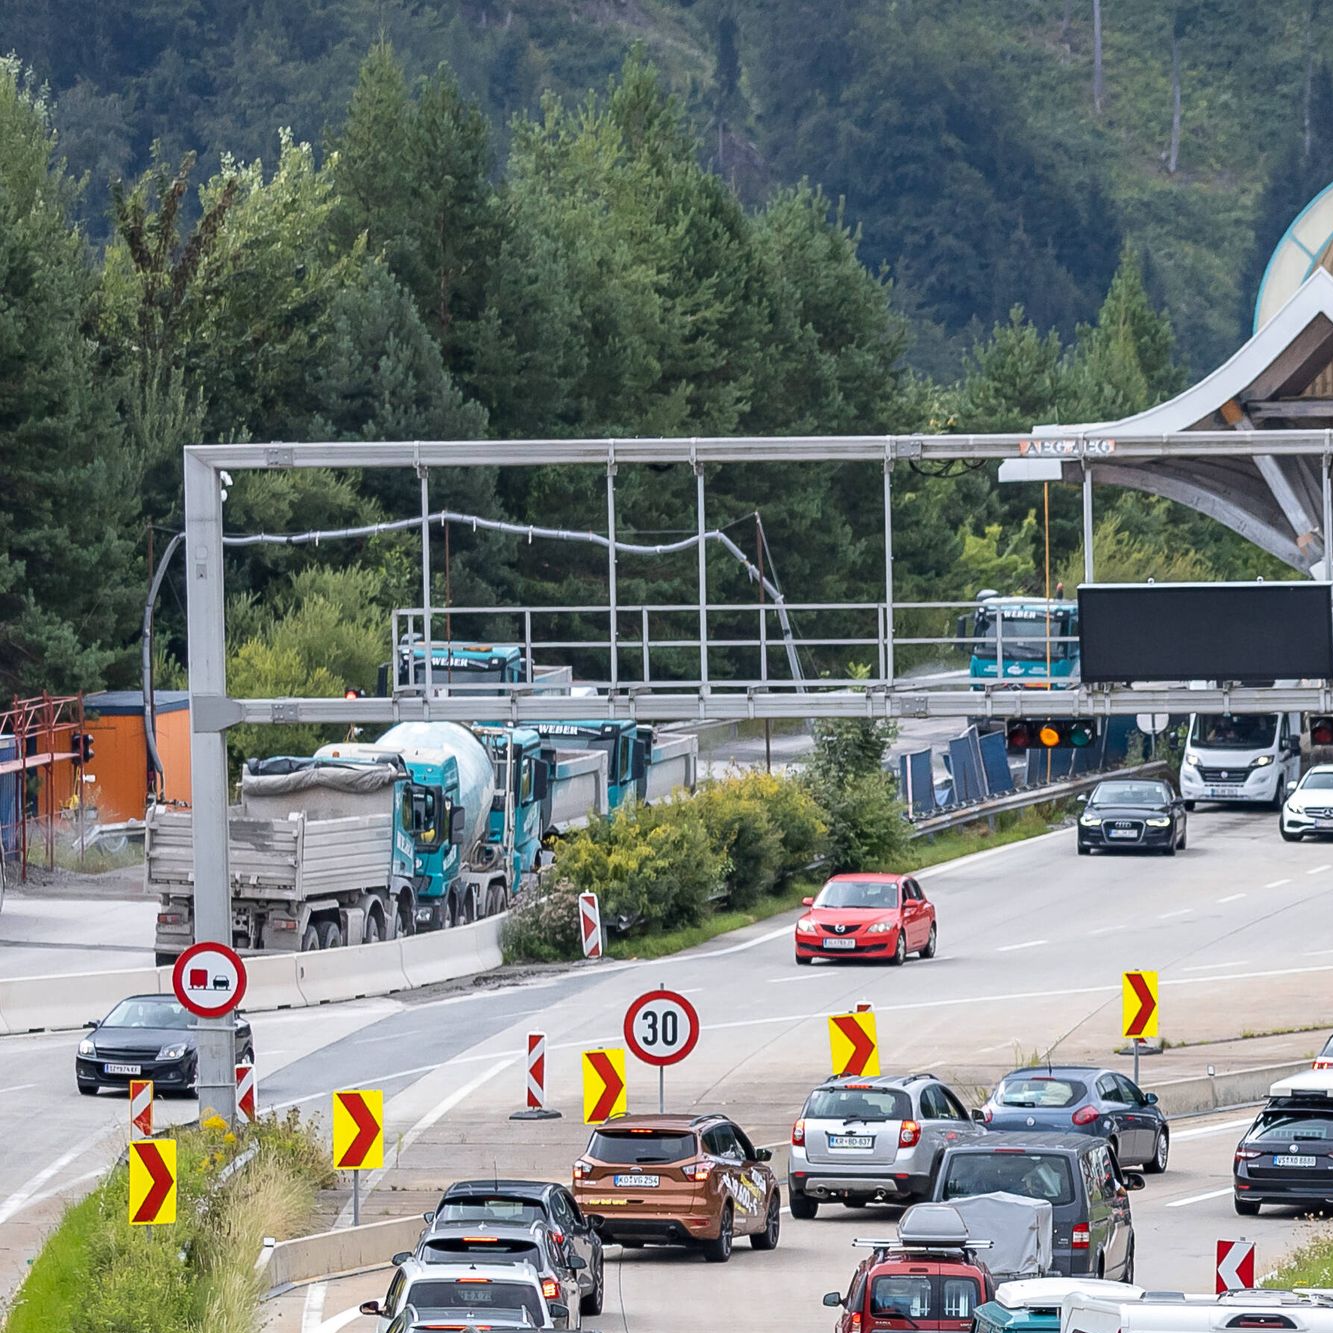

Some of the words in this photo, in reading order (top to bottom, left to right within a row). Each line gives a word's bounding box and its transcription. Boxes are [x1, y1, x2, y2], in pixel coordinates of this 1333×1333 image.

[538, 725, 578, 736] WEBER
[642, 1009, 679, 1047] 30
[644, 1176, 659, 1186] 254
